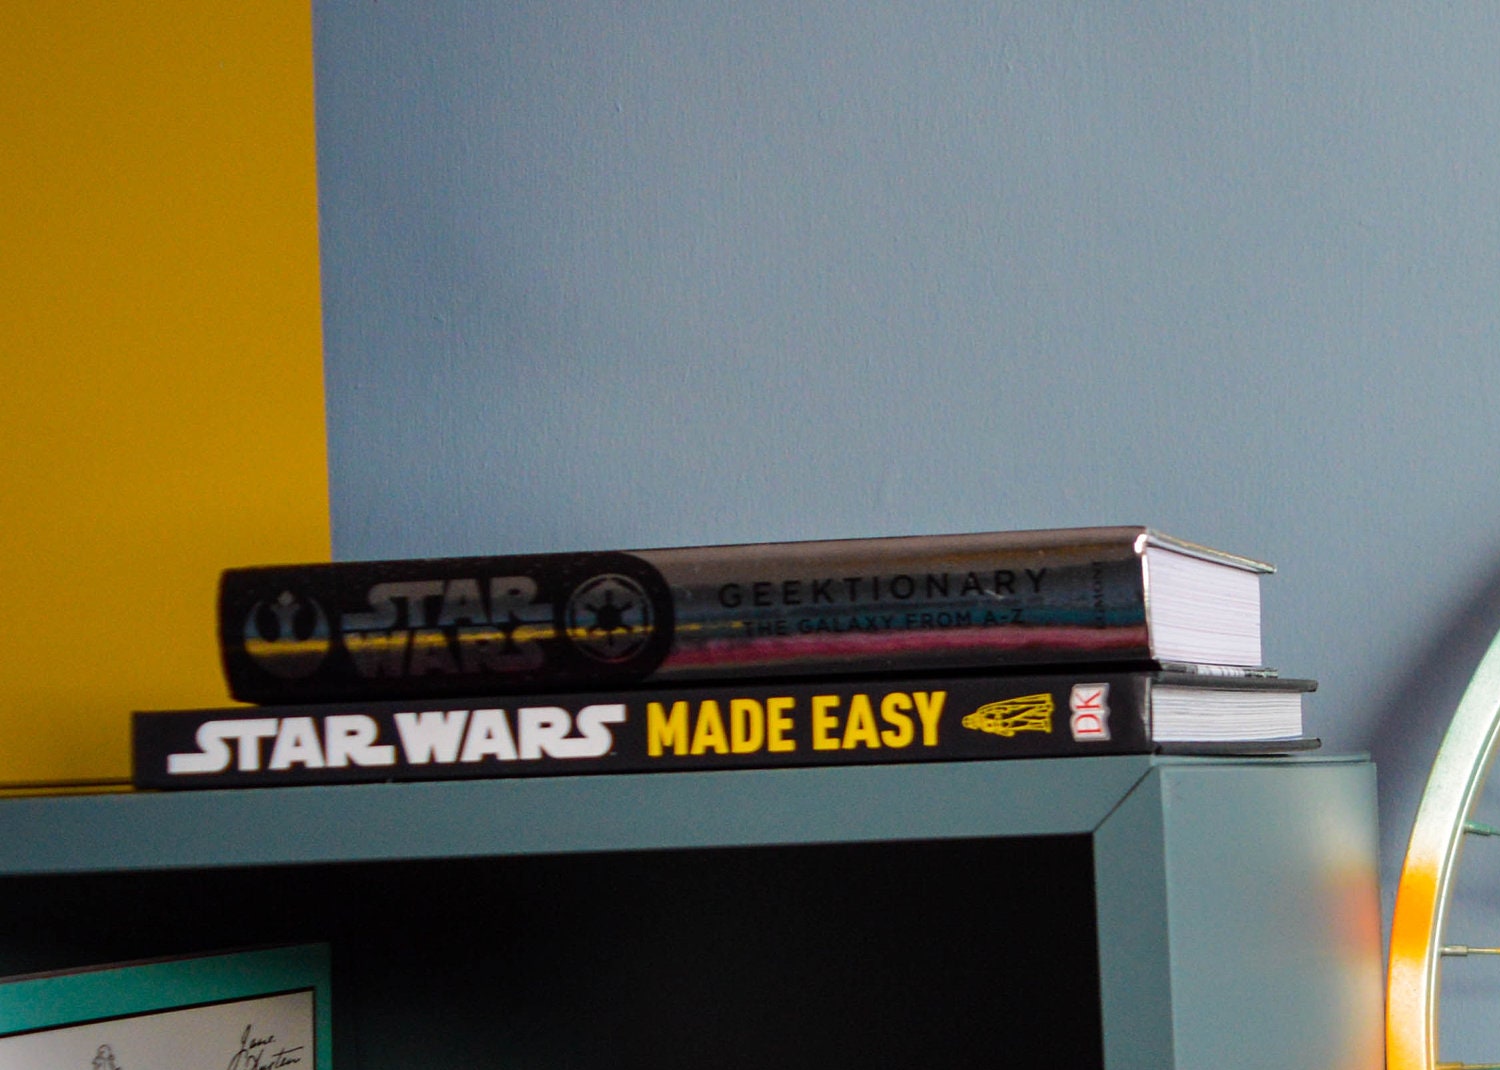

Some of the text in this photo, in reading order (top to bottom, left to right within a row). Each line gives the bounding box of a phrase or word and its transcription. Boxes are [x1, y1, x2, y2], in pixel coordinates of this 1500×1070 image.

[341, 576, 553, 629] STAR
[718, 568, 1049, 609] GEEKTIONARY
[741, 607, 1025, 638] THE GALAXY FROM A-Z
[338, 624, 546, 678] WARS
[167, 690, 947, 775] STAR WARS MADE EASY
[1074, 688, 1102, 737] DK
